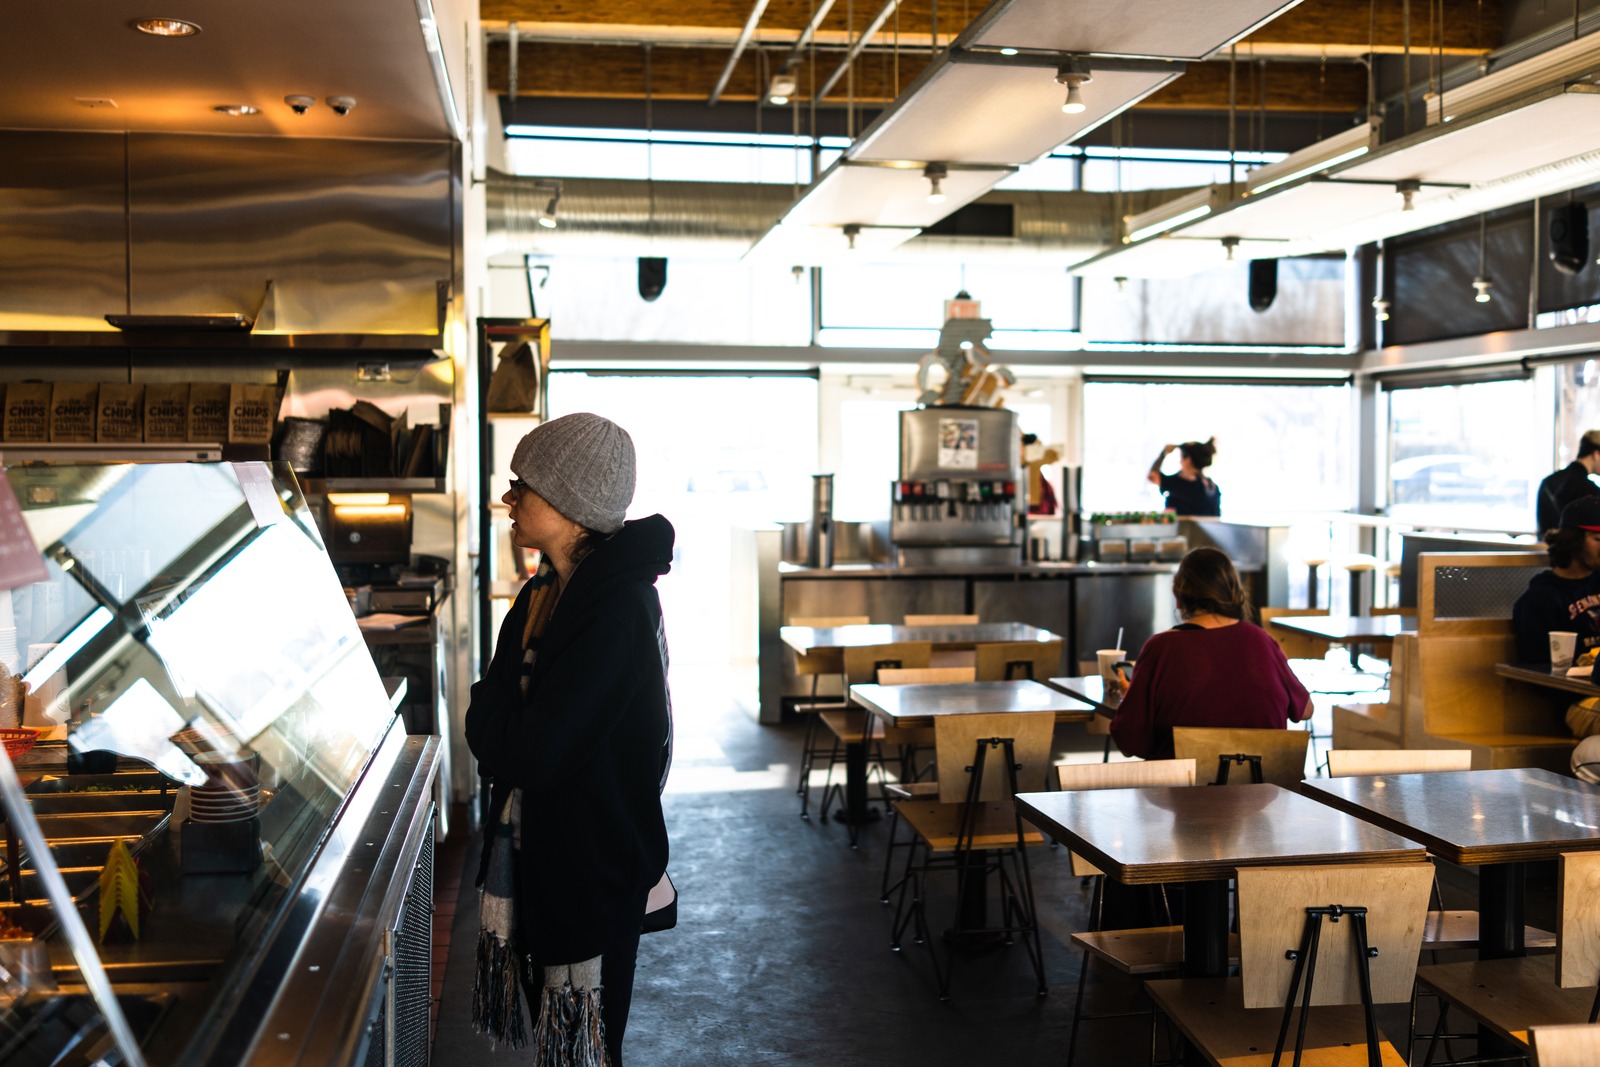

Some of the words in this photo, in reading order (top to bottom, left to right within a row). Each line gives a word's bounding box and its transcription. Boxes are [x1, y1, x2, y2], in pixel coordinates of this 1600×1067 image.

[9, 406, 46, 417] CHIPS
[55, 405, 90, 416] CHIPS
[149, 406, 185, 417] CHIPS
[234, 406, 269, 418] CHIPS
